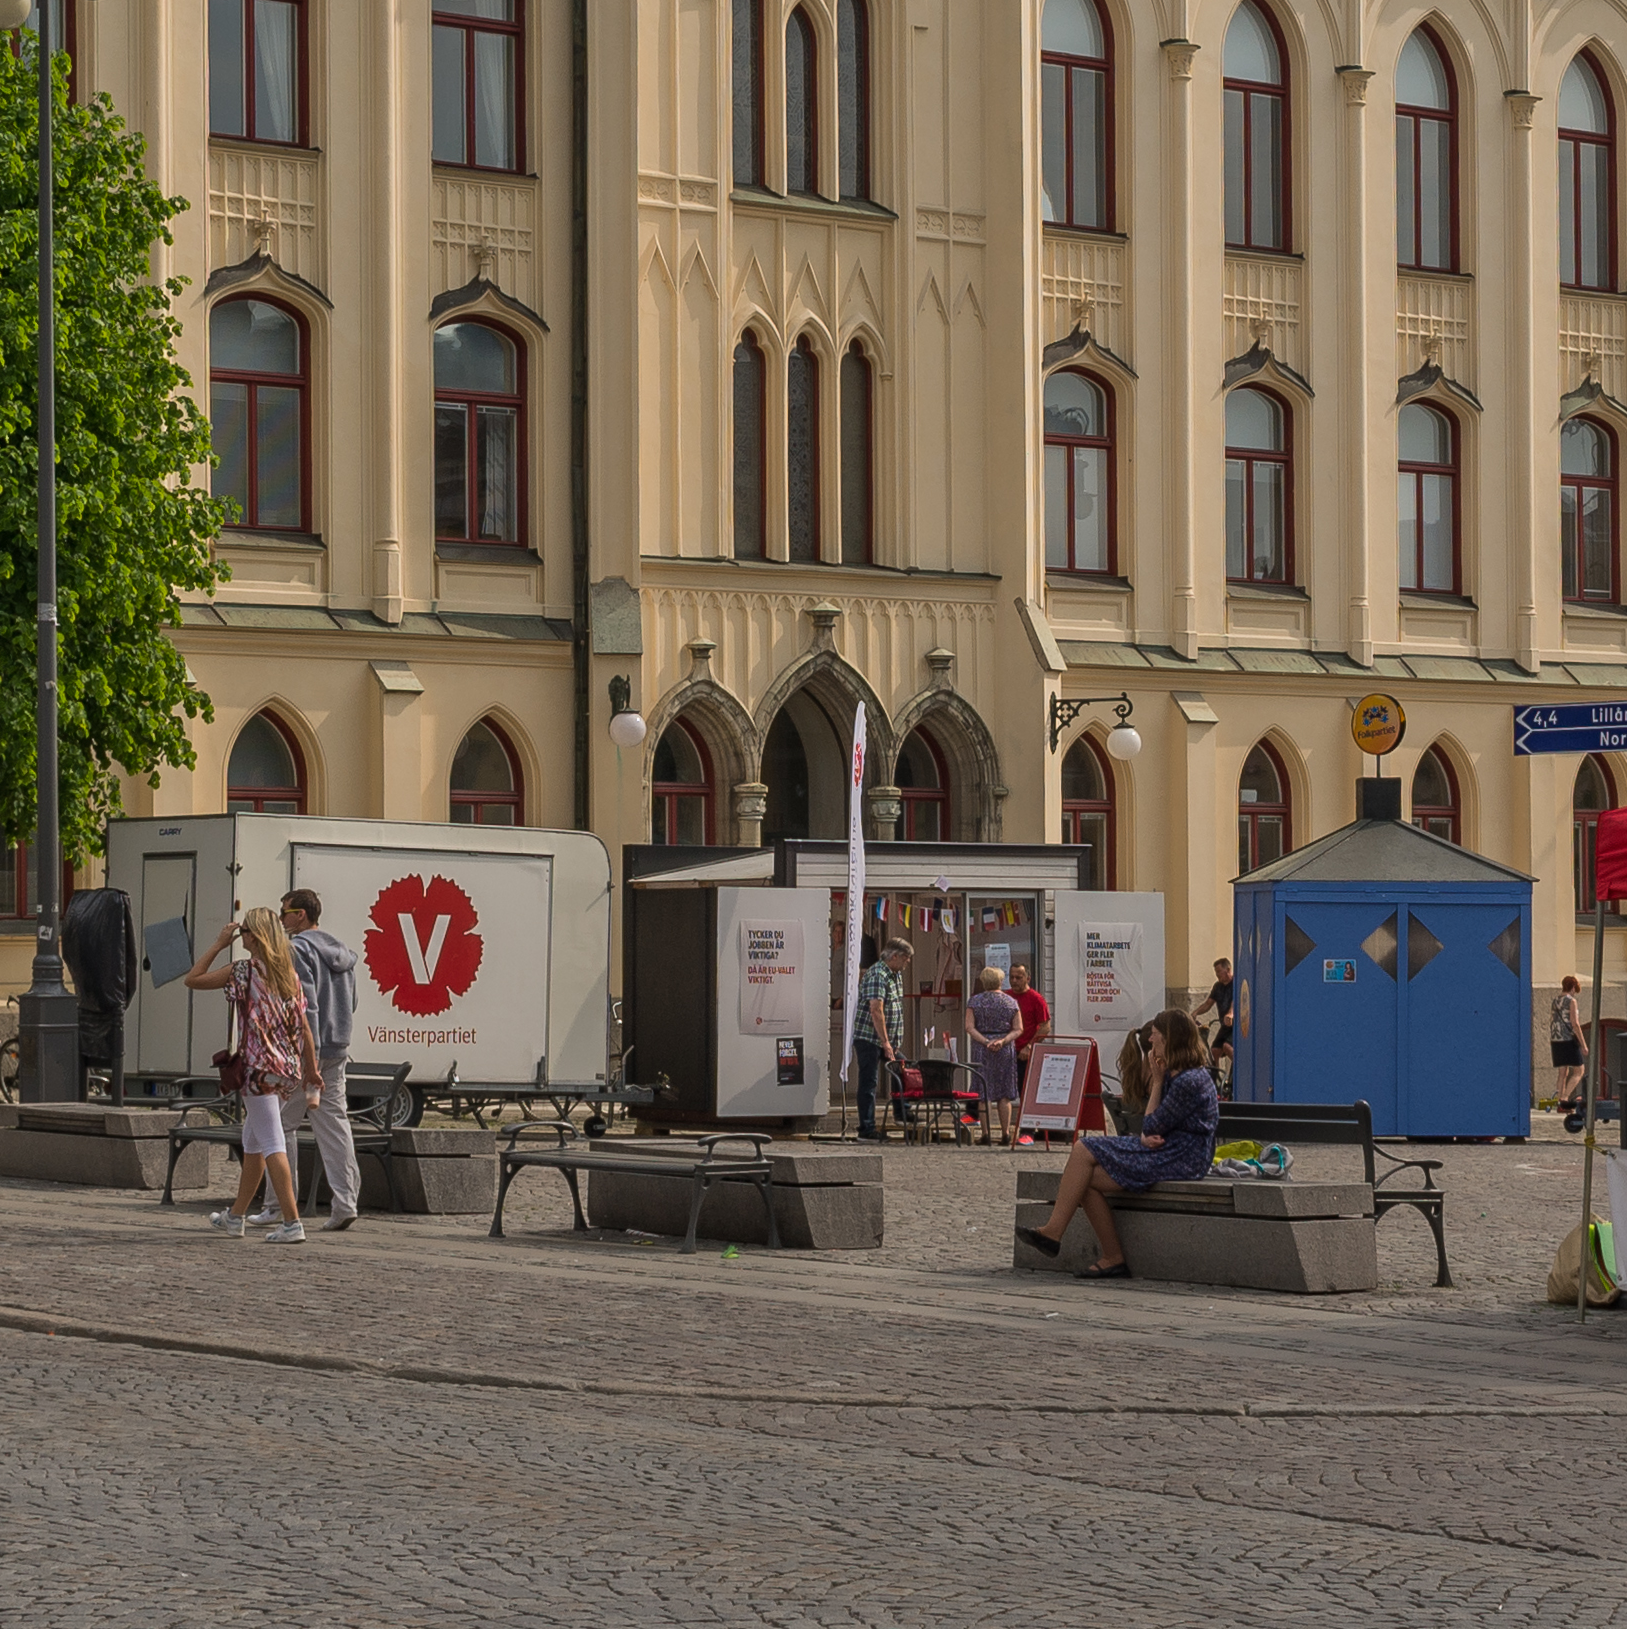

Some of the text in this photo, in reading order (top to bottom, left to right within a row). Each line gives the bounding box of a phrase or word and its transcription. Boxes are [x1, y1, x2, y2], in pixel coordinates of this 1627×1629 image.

[1533, 710, 1558, 728] 4,4
[1357, 725, 1396, 739] Folkpartiet
[748, 930, 784, 940] TYCKER DU
[1087, 932, 1100, 940] MER
[397, 913, 452, 985] V
[748, 940, 774, 950] JOBBEN
[1087, 941, 1131, 950] KLIMATARBETE
[748, 951, 779, 960] VIKTIGA?
[1087, 950, 1114, 959] GER FLER
[367, 1025, 477, 1047] Vänsterpartiet
